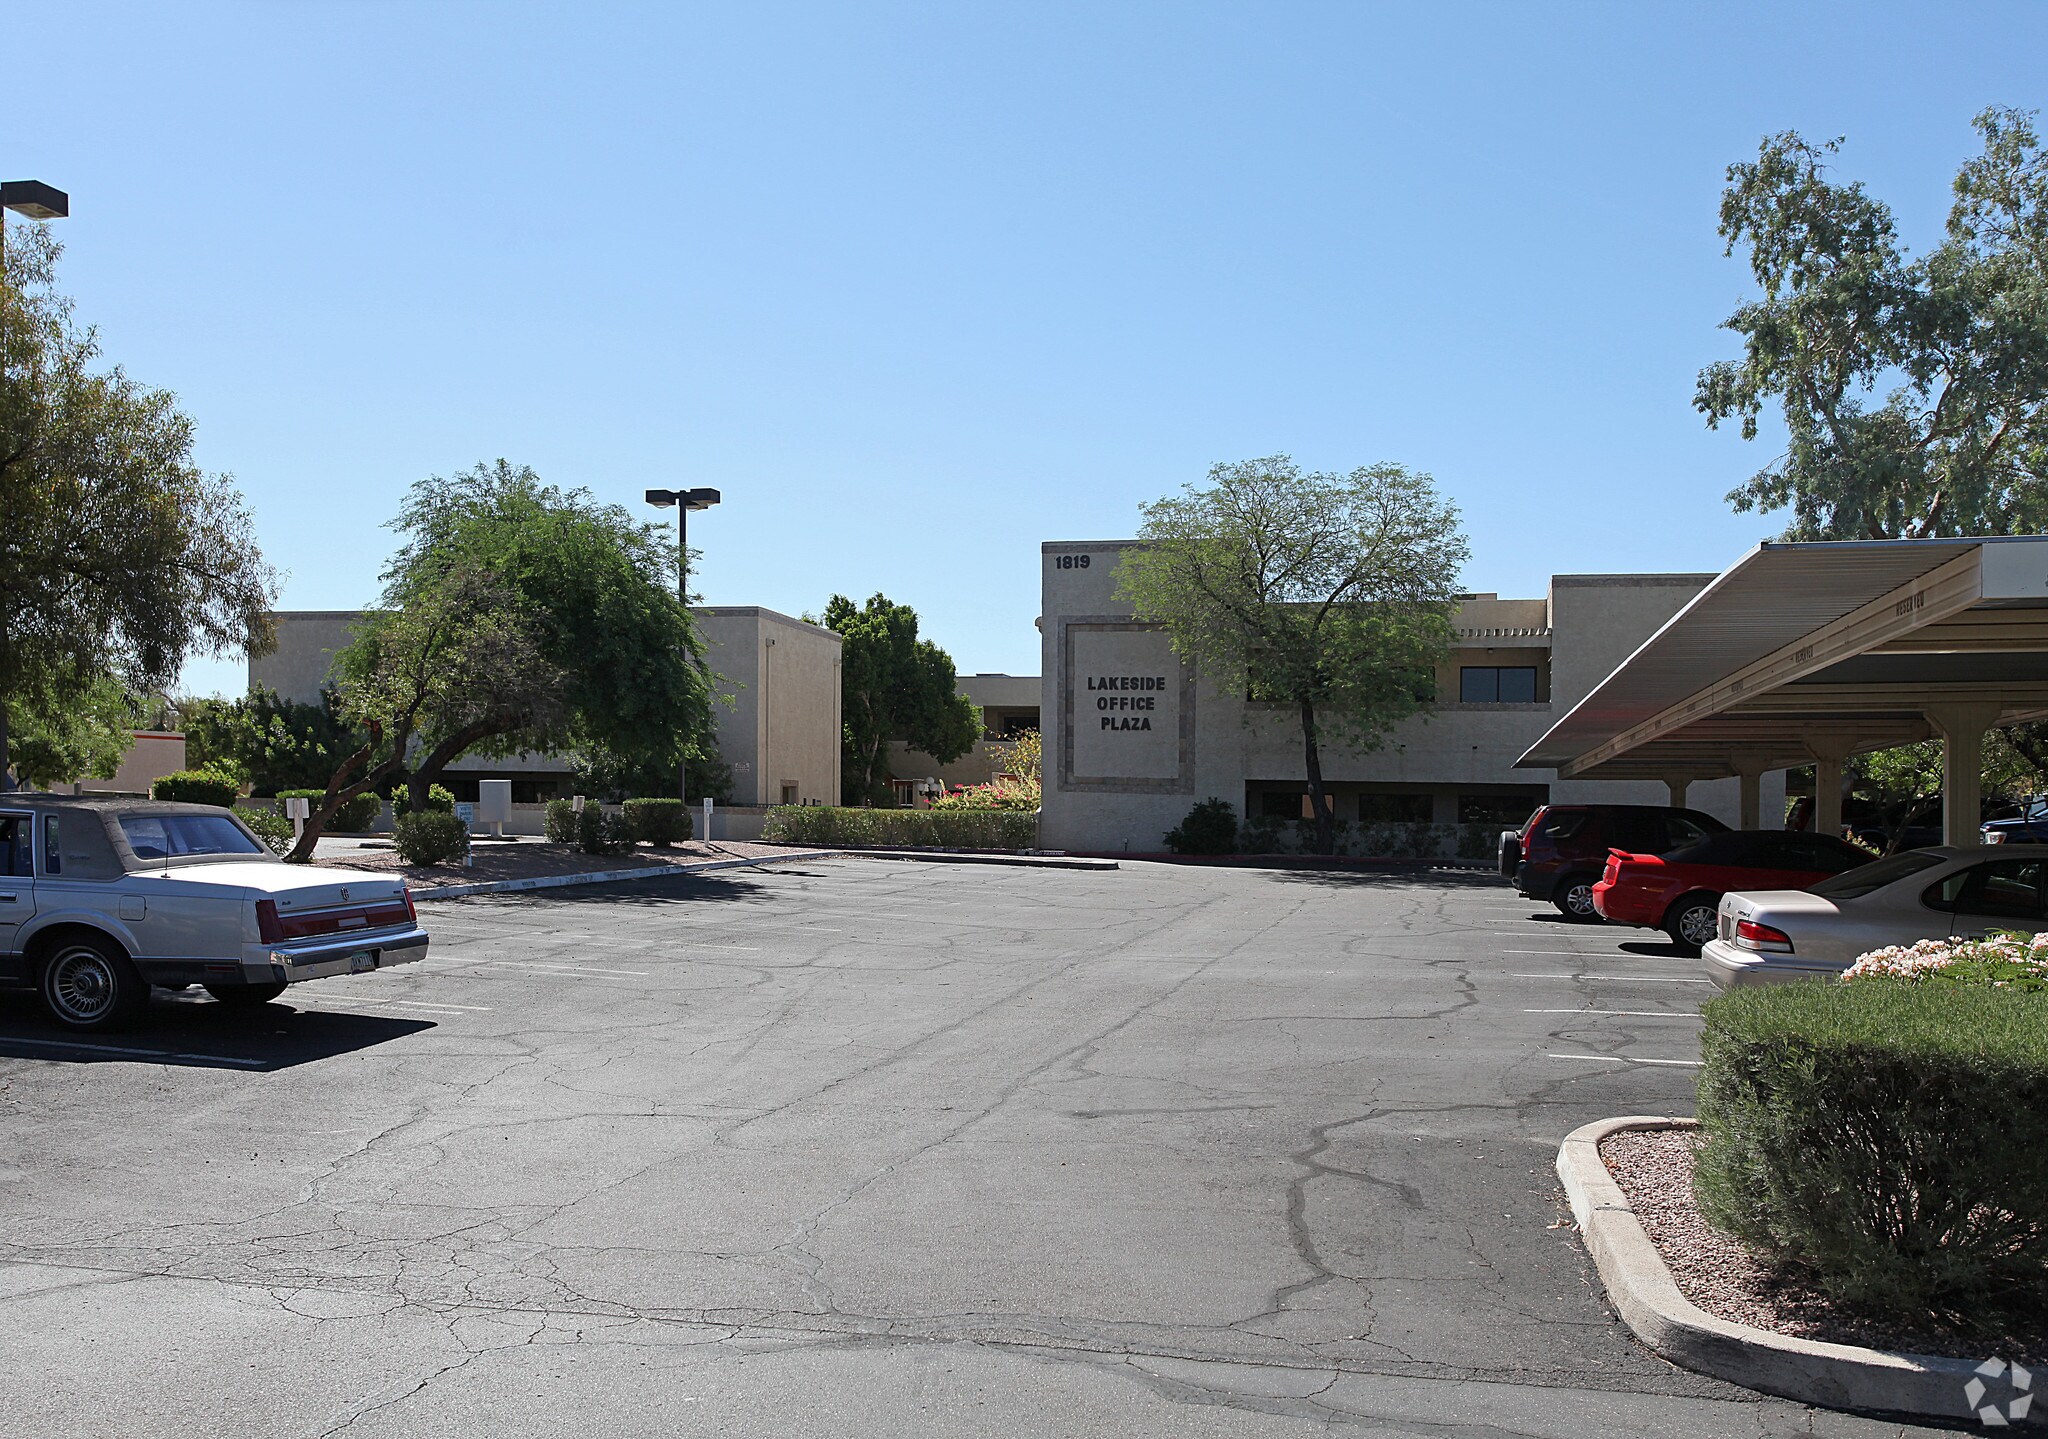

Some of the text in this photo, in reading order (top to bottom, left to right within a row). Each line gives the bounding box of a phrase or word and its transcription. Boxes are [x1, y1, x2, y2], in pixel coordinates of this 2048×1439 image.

[1056, 555, 1090, 569] 1819
[1895, 591, 1925, 617] RESERVED
[1087, 676, 1165, 690] LAKESIDE
[1096, 696, 1155, 710] OFFICE
[1101, 716, 1152, 731] PLAZA
